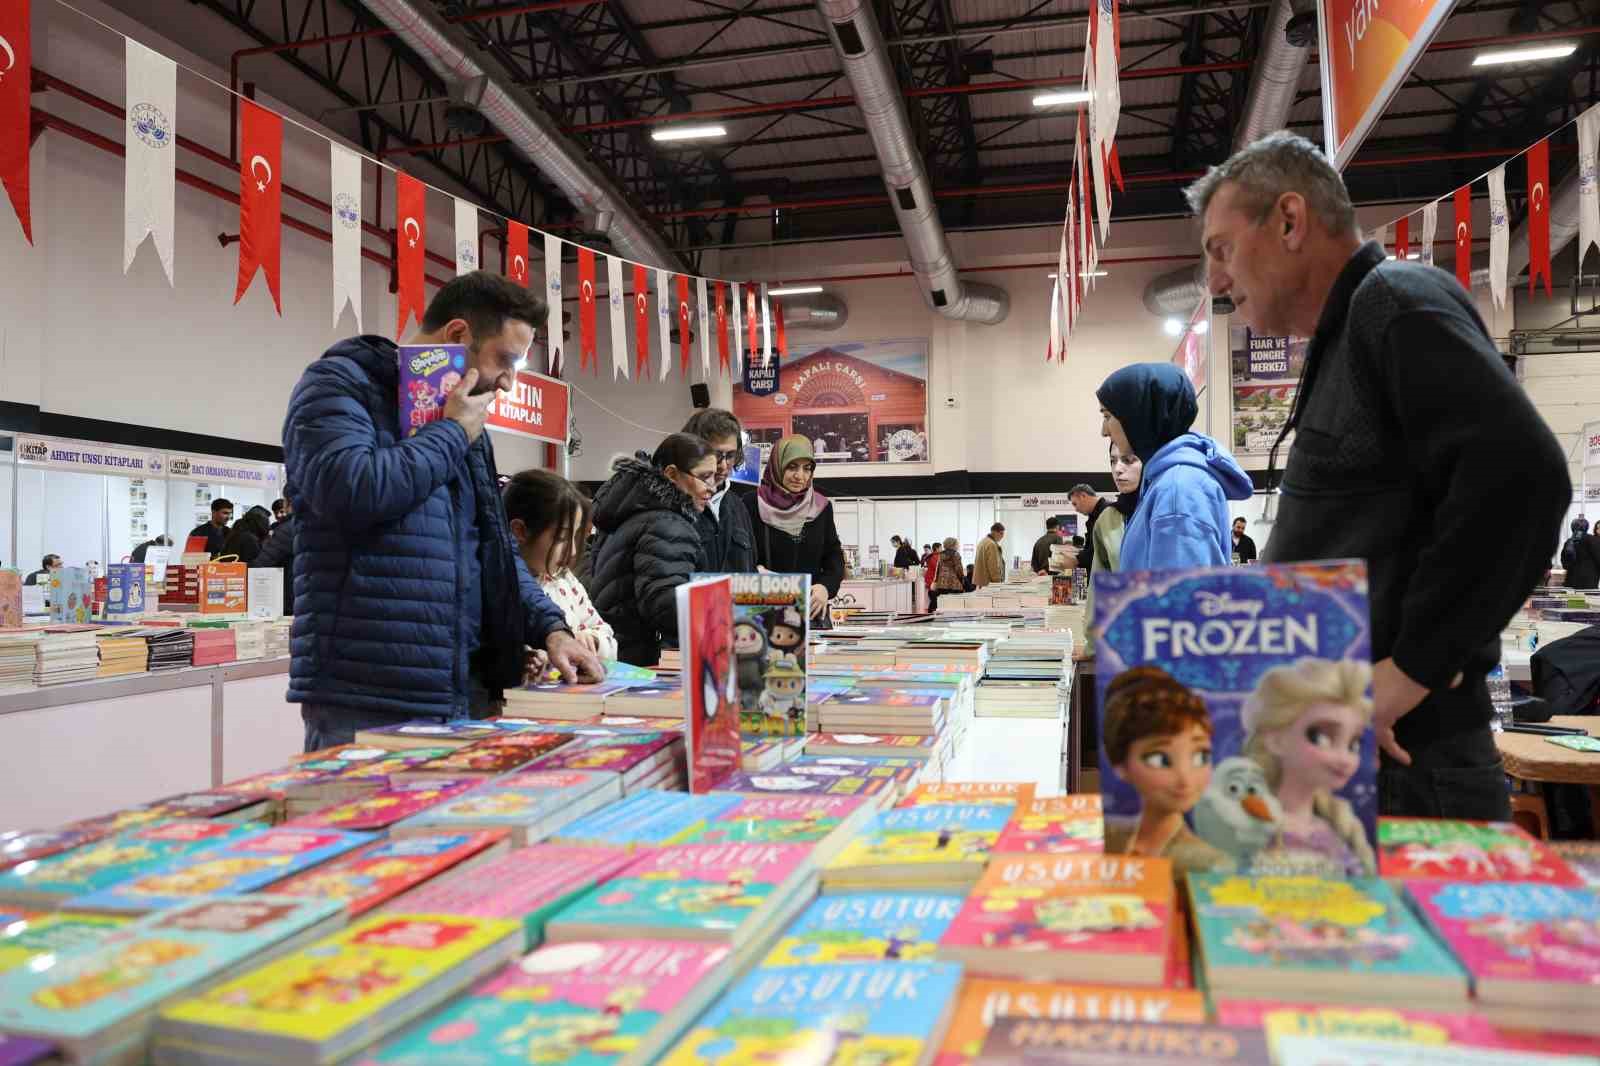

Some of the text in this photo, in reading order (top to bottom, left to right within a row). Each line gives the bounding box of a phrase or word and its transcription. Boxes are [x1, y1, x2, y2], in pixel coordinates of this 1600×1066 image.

[1250, 338, 1273, 350] FUAR
[1275, 338, 1286, 348] VE
[1250, 350, 1287, 361] KONGRE
[748, 368, 776, 379] KAPALI
[792, 362, 831, 392] KAPALI
[750, 380, 774, 392] ÇARŞI
[50, 449, 81, 462] AHMET
[761, 575, 800, 593] BOOK
[1193, 591, 1264, 621] Disney
[1142, 613, 1318, 660] FROZEN
